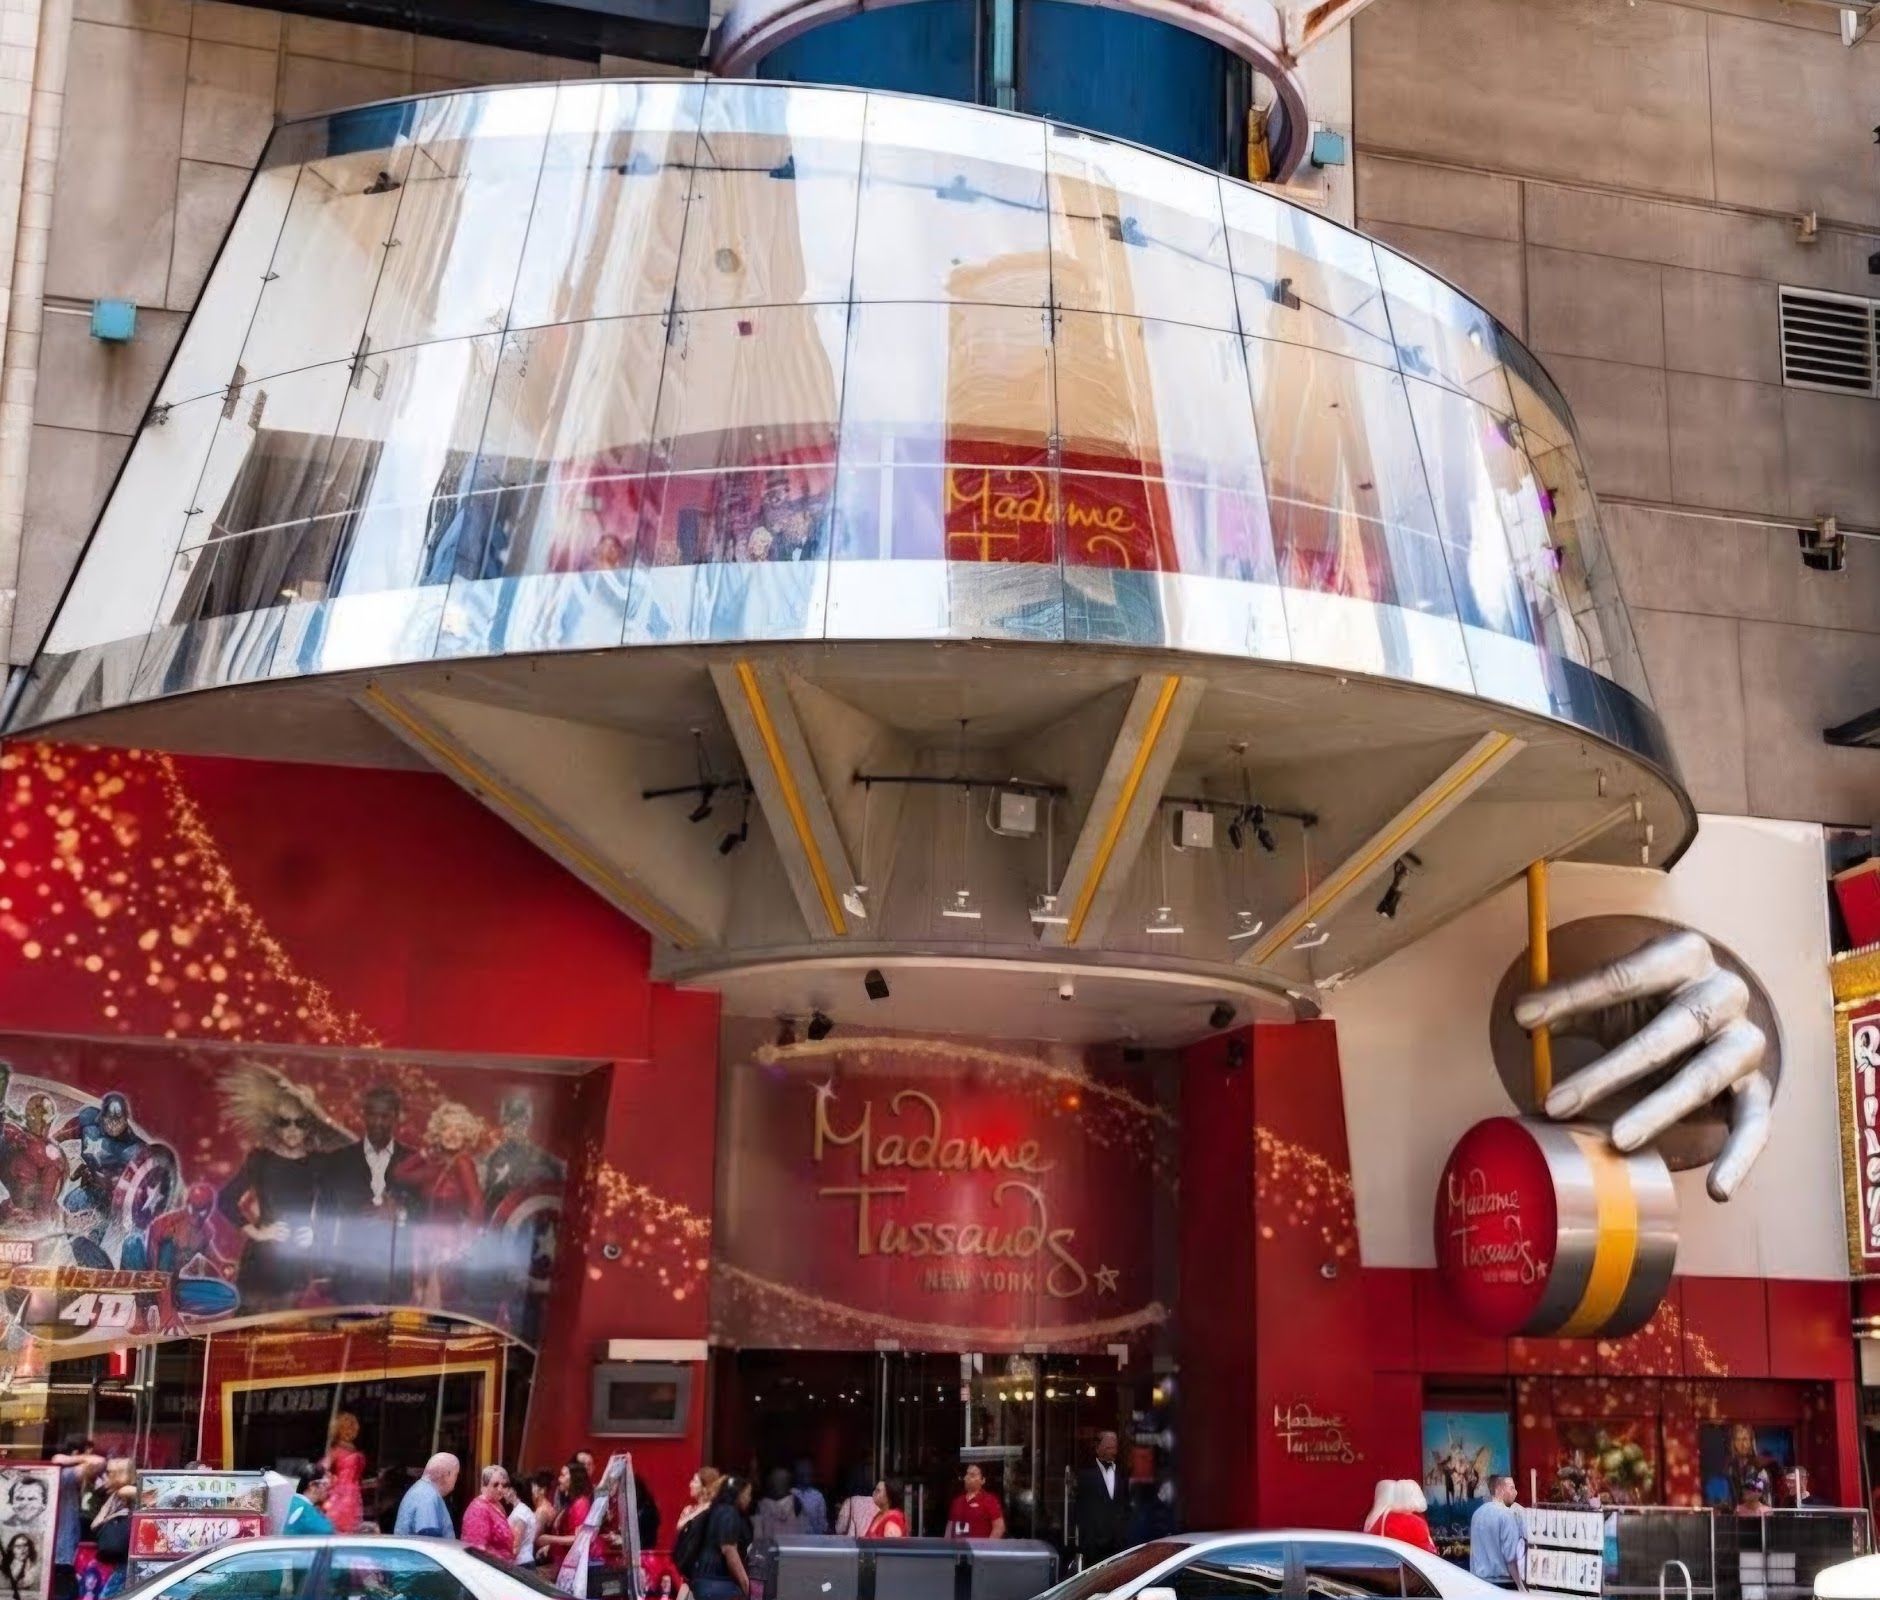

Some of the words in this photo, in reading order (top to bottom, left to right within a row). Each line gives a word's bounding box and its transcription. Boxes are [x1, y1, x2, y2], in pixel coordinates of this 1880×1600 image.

[813, 1088, 1054, 1174] Madame
[1449, 1168, 1520, 1216] Madame
[819, 1180, 1087, 1297] Tussauds
[1450, 1215, 1535, 1285] Tussauds
[924, 1271, 970, 1289] NEW
[981, 1271, 1034, 1291] YORK
[59, 1293, 136, 1327] 4D
[1274, 1403, 1344, 1429] Madame
